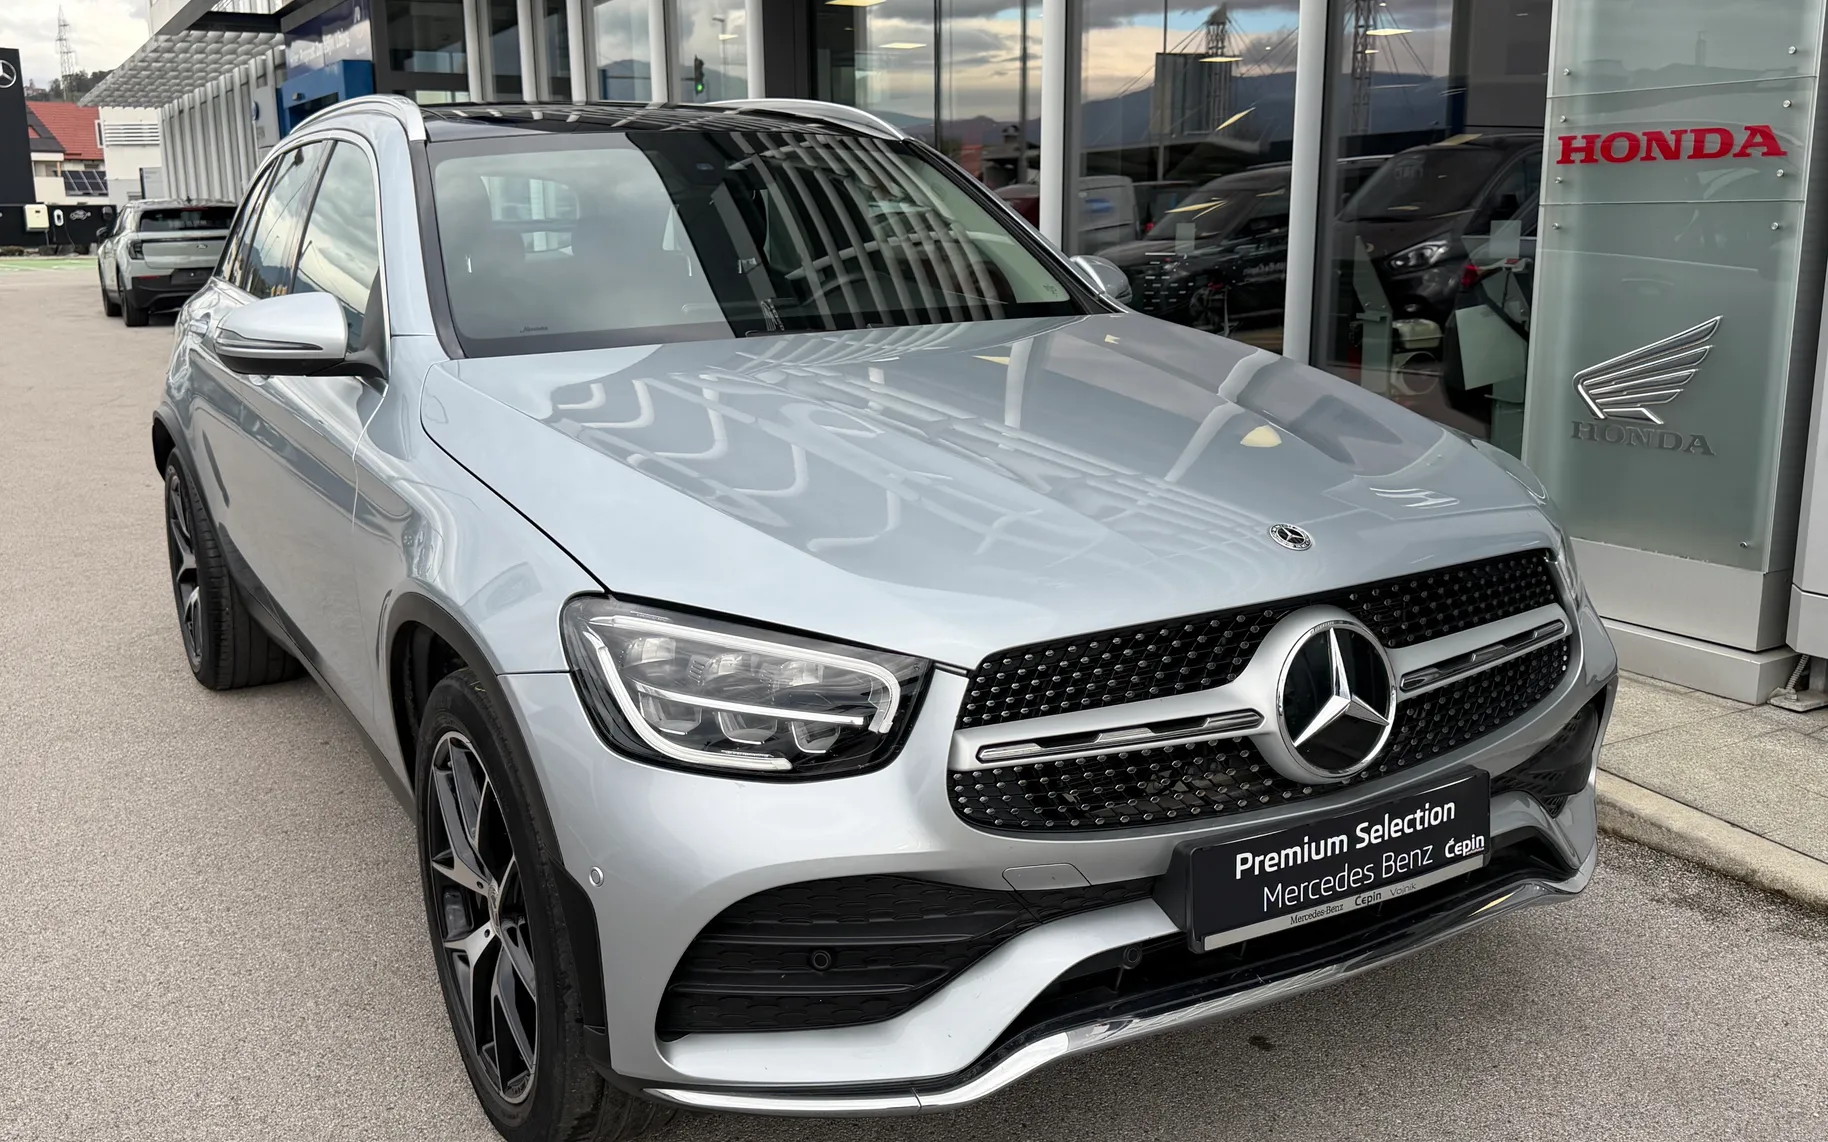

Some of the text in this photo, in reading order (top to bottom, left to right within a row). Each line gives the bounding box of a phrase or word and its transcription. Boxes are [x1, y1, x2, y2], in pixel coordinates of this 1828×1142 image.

[1556, 124, 1788, 165] HONDA
[1570, 420, 1717, 456] HONDA
[1235, 800, 1455, 880] Premium Selection
[1263, 844, 1433, 912] Mercedes Benz
[1290, 903, 1344, 925] Mercedes-Benz
[1389, 882, 1417, 897] Vojnik
